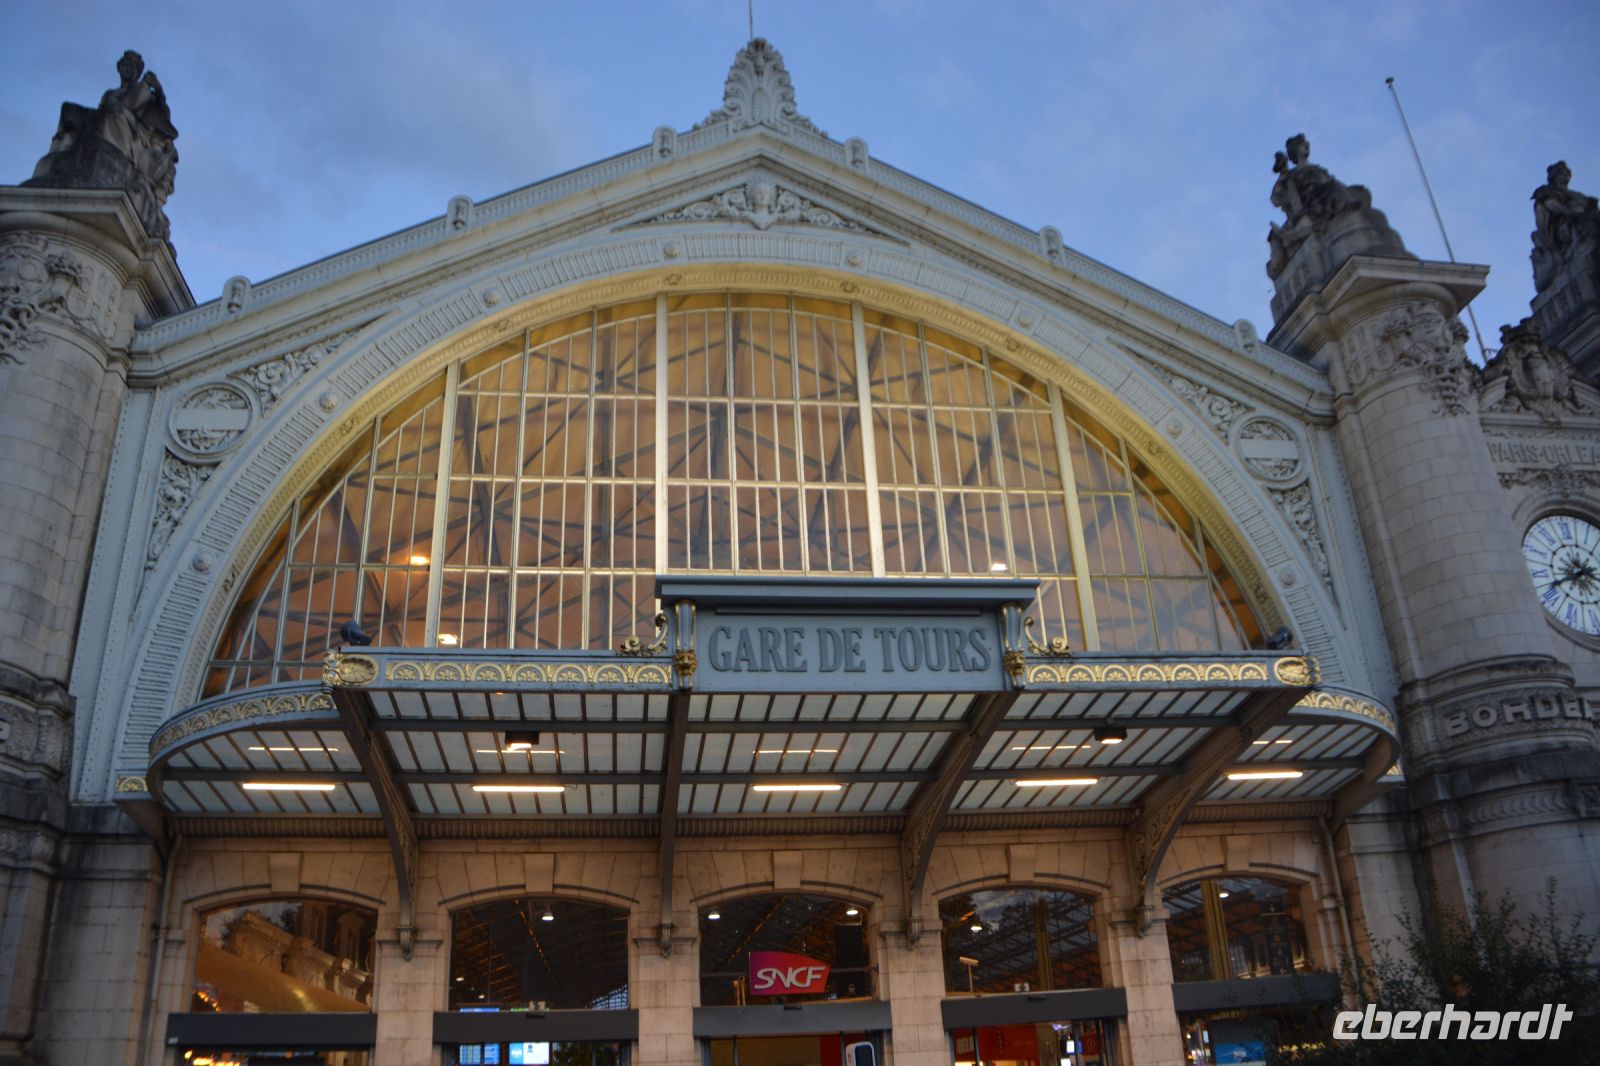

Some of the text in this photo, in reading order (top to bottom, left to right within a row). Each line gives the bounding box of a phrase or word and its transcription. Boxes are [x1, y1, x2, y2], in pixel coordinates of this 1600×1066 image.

[707, 625, 992, 672] GARE DE TOURS
[754, 966, 826, 989] SNCF
